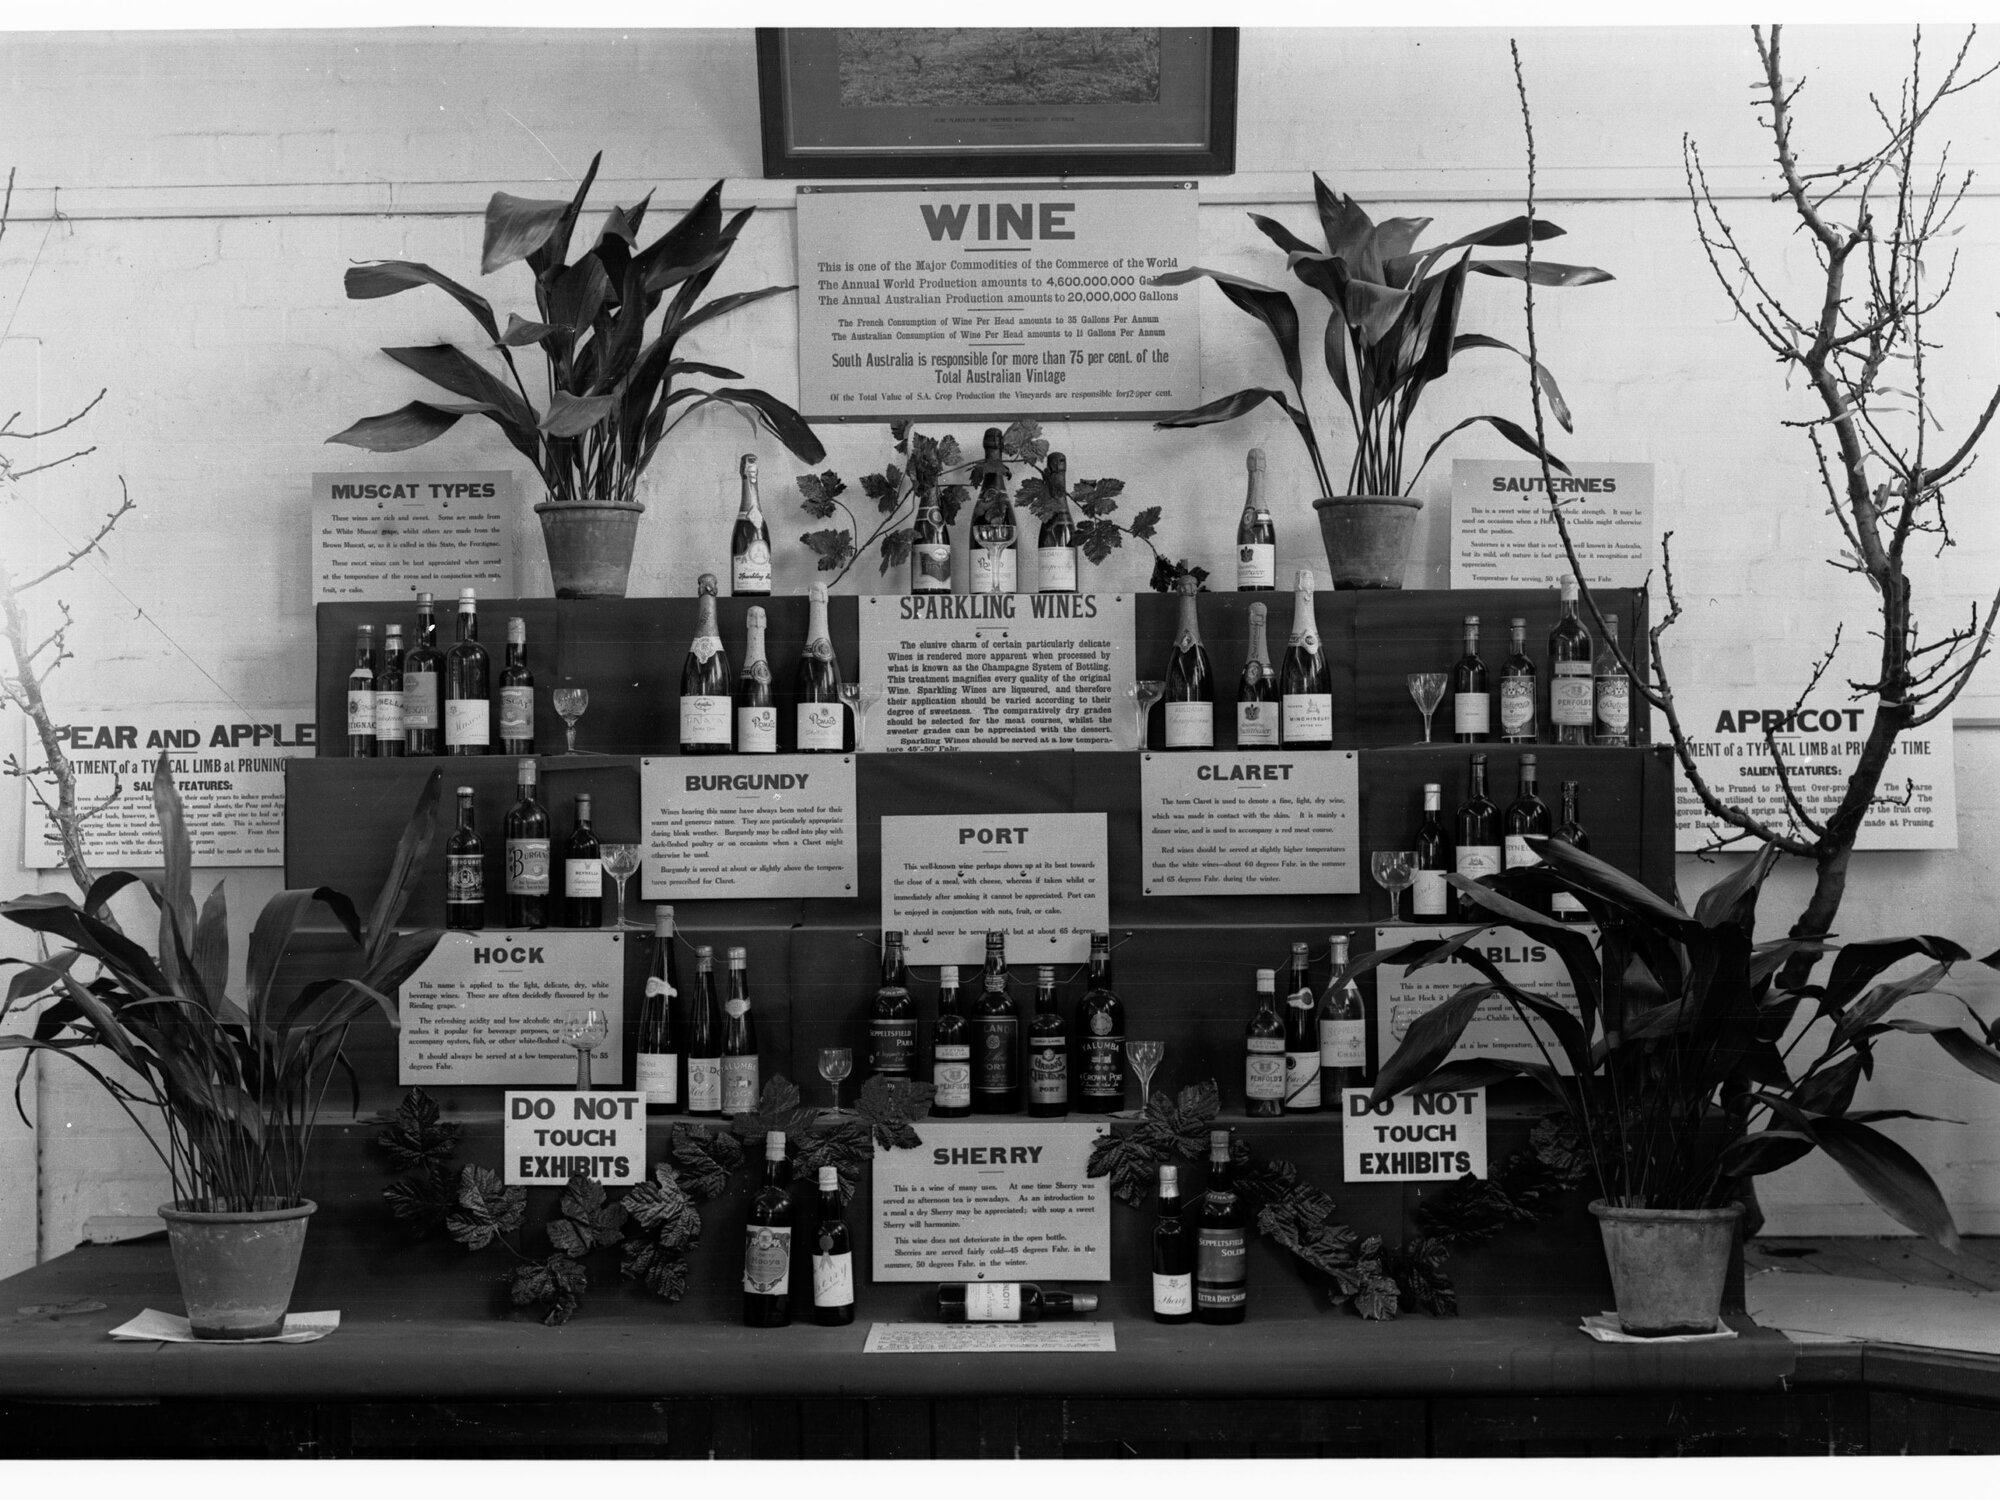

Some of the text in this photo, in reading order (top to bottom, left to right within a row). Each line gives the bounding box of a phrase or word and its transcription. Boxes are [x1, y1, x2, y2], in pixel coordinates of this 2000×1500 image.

[919, 202, 1075, 241] WINE
[817, 257, 1178, 272] This is one of the Major Commodities of the Commerce of the World
[818, 295, 838, 305] The
[841, 294, 880, 305] Annual
[884, 293, 941, 304] Australian
[945, 292, 1003, 304] Production
[1007, 293, 1053, 303] amounts
[1054, 292, 1065, 302] to
[1138, 290, 1178, 301] Gallons
[831, 348, 1169, 368] South Australia is responsible for more than 75 per cent. of the
[934, 368, 1066, 384] Total Australian Vintage
[331, 482, 495, 499] MUSCAT TYPES
[1492, 476, 1616, 493] SAUTERNES
[900, 594, 1098, 620] SPARKLING WINES
[899, 639, 1111, 650] The elusive charm of certain particularly delicate
[887, 650, 1111, 661] Wines is rendered more apparent when processed by
[887, 663, 908, 672] what
[911, 663, 919, 672] is
[921, 663, 948, 672] known
[965, 662, 979, 671] the
[981, 662, 1029, 673] Champagne
[1031, 662, 1062, 672] System
[1064, 662, 1073, 671] of
[1075, 661, 1110, 672] Bottling.
[1715, 709, 1864, 734] APRICOT
[145, 729, 201, 751] AND
[209, 724, 316, 748] APPLE
[1723, 742, 1734, 756] of
[1736, 746, 1742, 756] a
[1799, 741, 1828, 756] LIMB
[1830, 743, 1842, 755] at
[1900, 740, 1931, 755] TIME
[118, 760, 130, 774] of
[132, 764, 138, 774] a
[141, 759, 190, 774] TYCAL
[192, 758, 222, 774] LIMB
[223, 758, 235, 773] at
[1196, 763, 1293, 781] CLARET
[178, 780, 232, 791] FEATURES:
[685, 773, 809, 791] BURGUNDY
[958, 827, 1029, 844] PORT
[902, 862, 918, 870] This
[919, 862, 956, 870] well-known
[958, 862, 974, 872] wine
[976, 861, 1001, 870] perhaps
[1003, 861, 1024, 871] shows
[1069, 860, 1095, 868] towards
[473, 946, 544, 964] HOCK
[511, 1097, 639, 1120] DO NOT
[1350, 1092, 1478, 1117] DO NOT
[533, 1129, 616, 1146] TOUCH
[1374, 1124, 1457, 1142] TOUCH
[933, 1145, 1043, 1165] SHERRY
[1360, 1151, 1471, 1175] EXHIBITS
[520, 1156, 630, 1178] EXHIBITS
[893, 1236, 909, 1244] This
[930, 1235, 946, 1244] does
[962, 1234, 1000, 1243] deteriorate
[1002, 1234, 1010, 1242] in
[1012, 1234, 1024, 1242] the
[1045, 1232, 1066, 1241] bottle.
